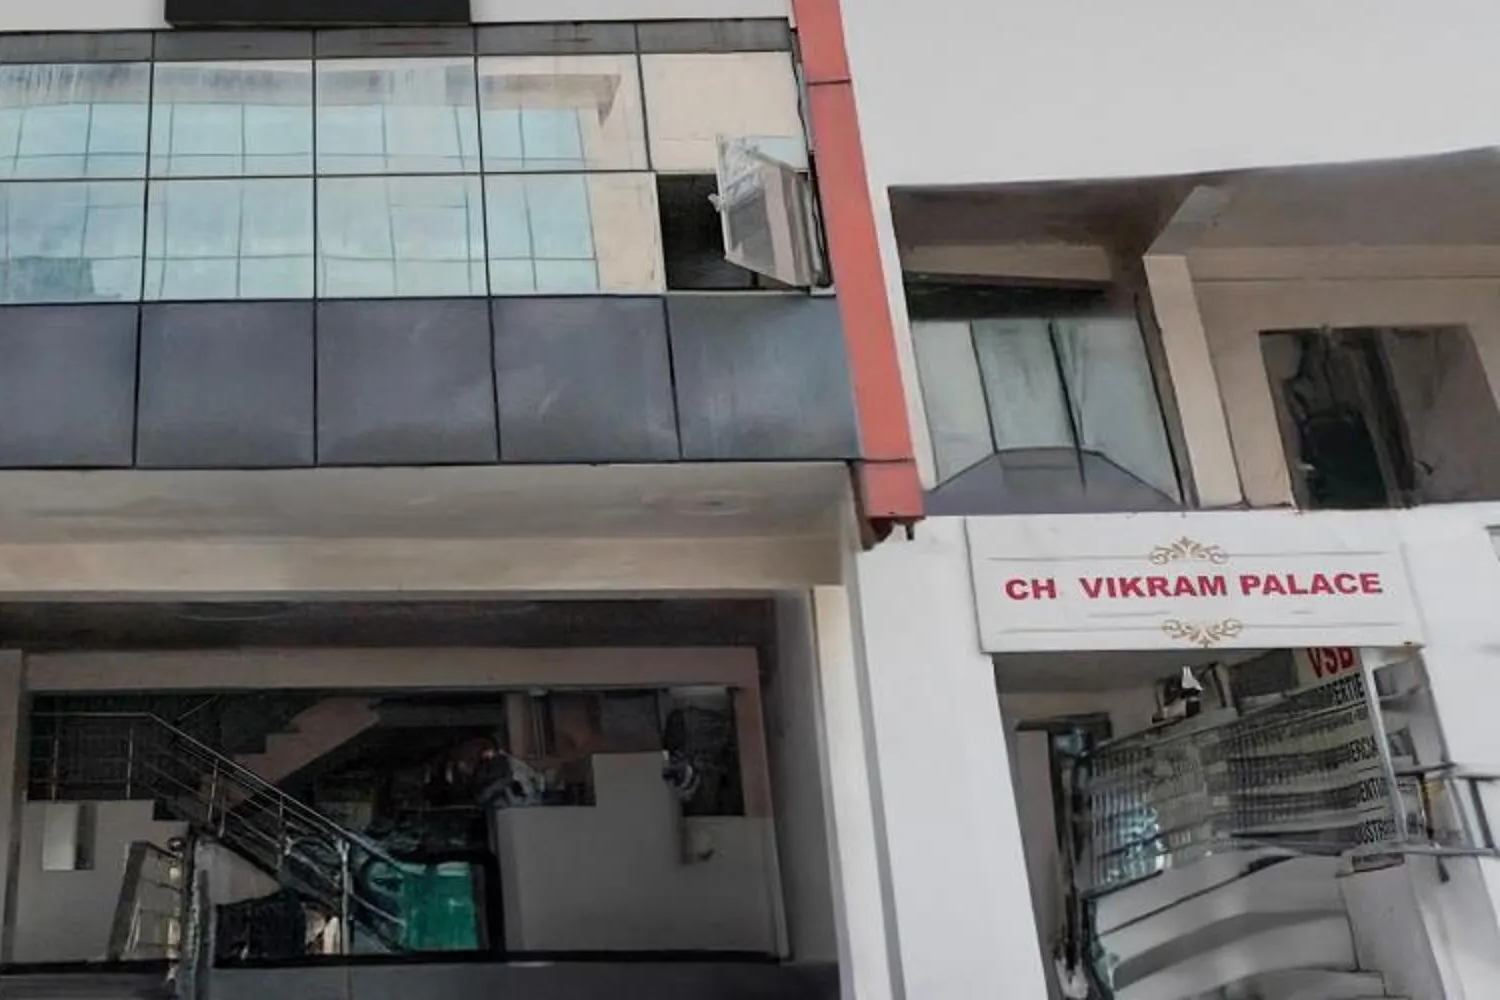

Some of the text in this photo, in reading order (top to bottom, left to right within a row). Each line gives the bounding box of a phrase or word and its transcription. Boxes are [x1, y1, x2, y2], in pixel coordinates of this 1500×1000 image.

[1005, 572, 1384, 600] CH VIKRAM PALACE
